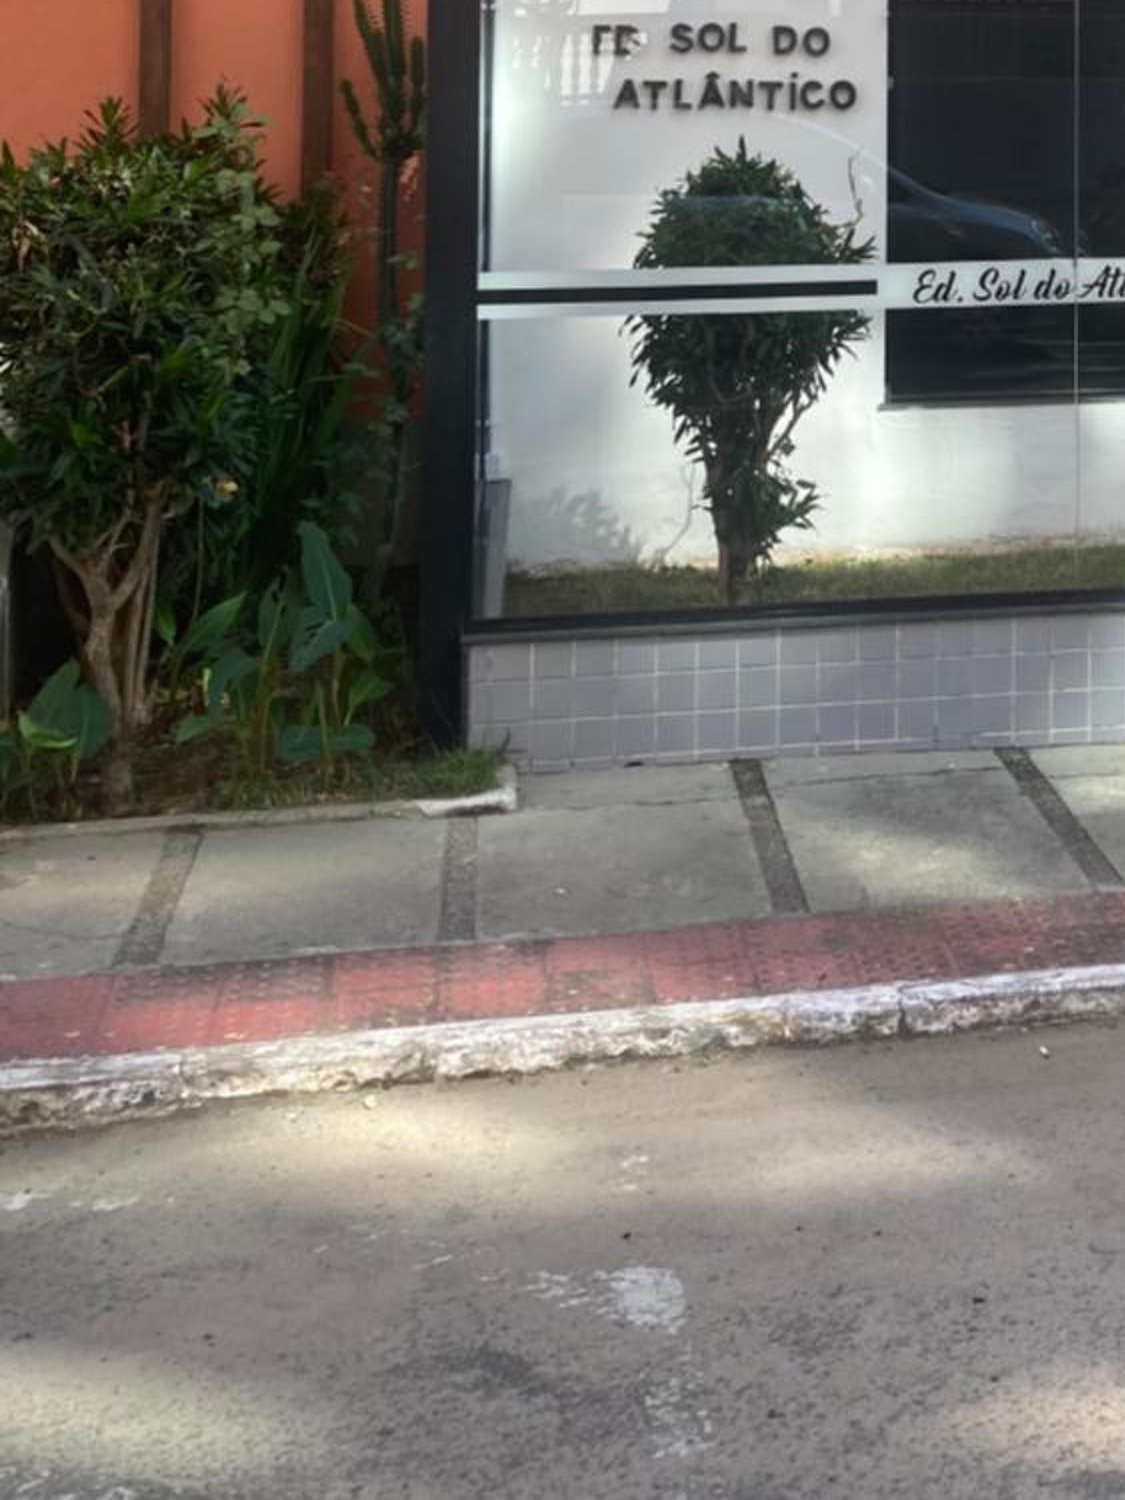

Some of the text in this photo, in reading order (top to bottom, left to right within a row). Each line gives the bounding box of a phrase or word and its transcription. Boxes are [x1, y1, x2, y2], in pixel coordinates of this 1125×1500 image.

[670, 21, 748, 54] SOL
[771, 24, 831, 58] DO
[912, 268, 965, 305] Ed.
[972, 266, 1028, 302] Sol
[1032, 267, 1072, 301] do
